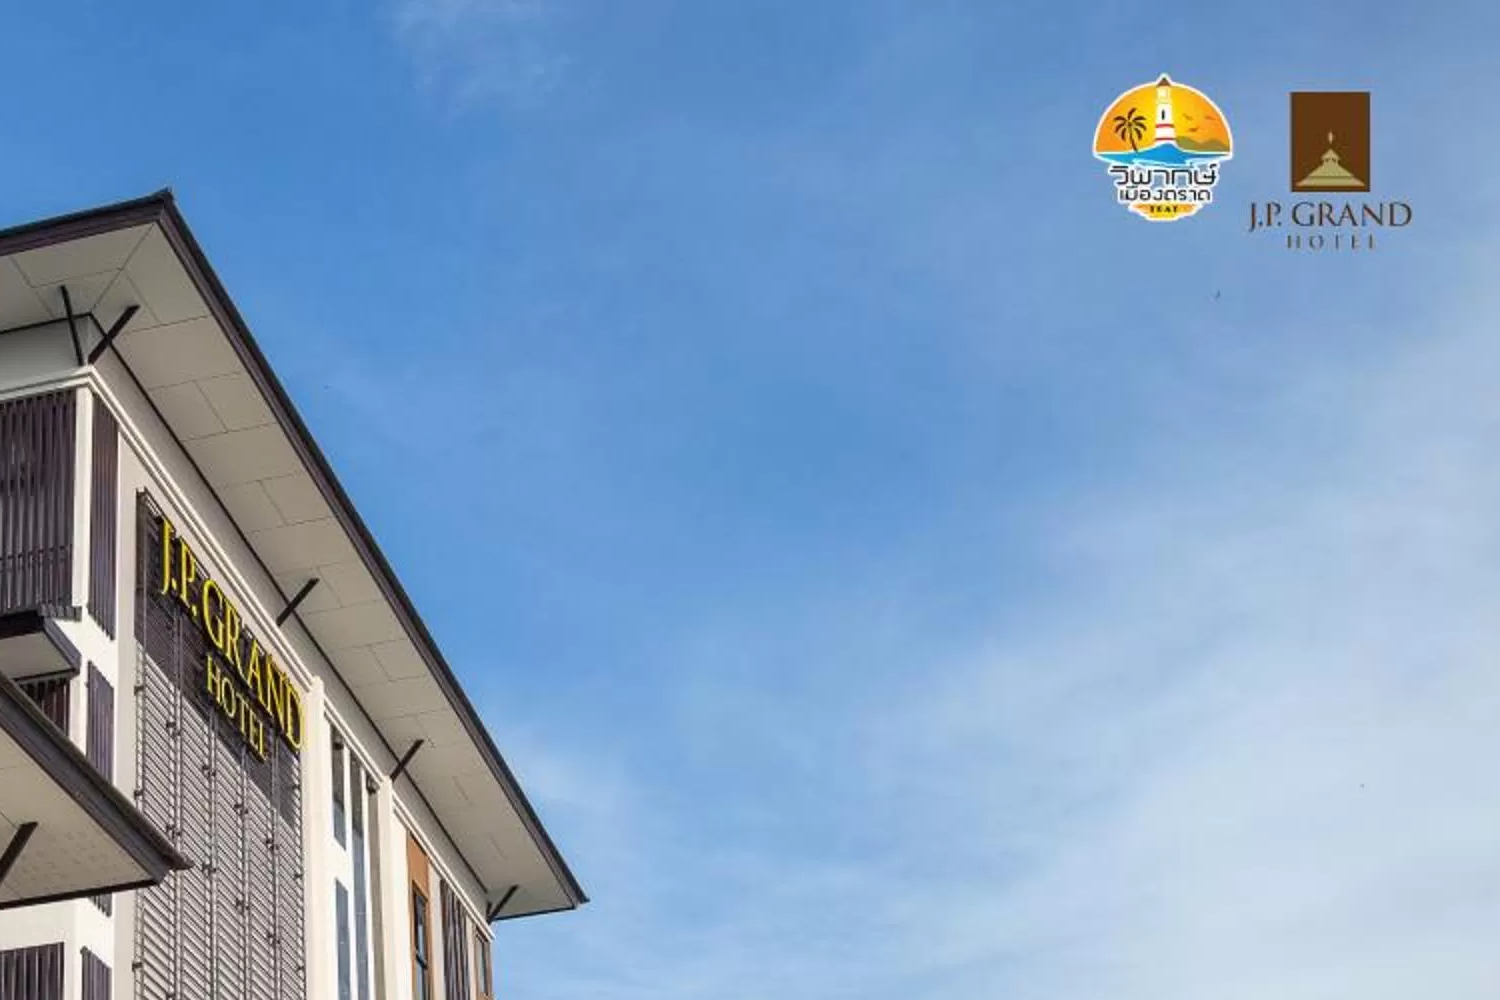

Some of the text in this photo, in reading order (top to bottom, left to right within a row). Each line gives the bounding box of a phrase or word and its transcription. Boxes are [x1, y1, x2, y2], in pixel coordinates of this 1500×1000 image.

[160, 518, 302, 749] J.P. GRAND
[205, 655, 266, 761] HOTEL
